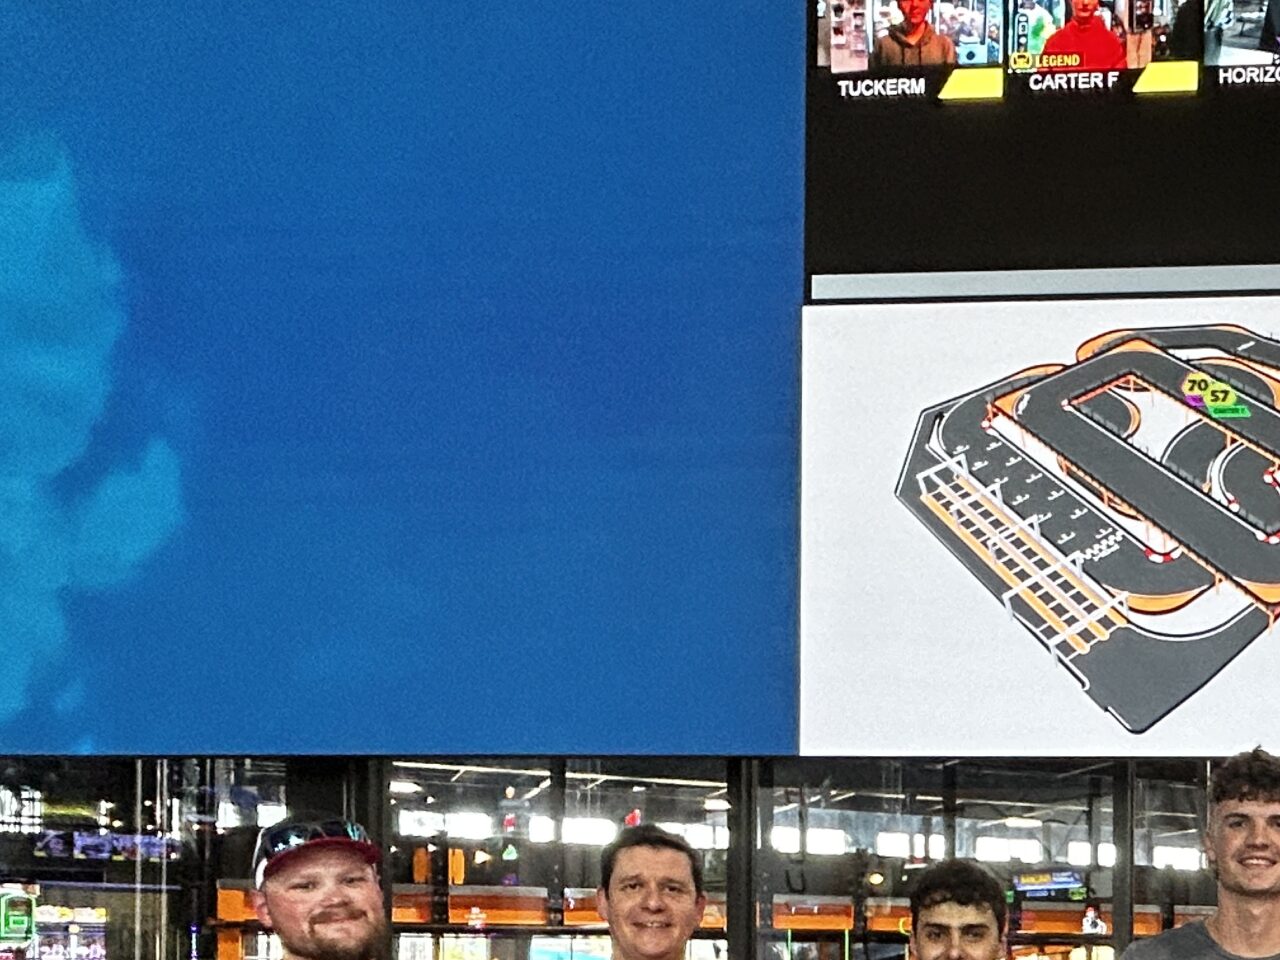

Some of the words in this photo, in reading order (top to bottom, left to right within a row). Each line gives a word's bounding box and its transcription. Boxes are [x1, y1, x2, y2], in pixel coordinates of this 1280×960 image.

[1035, 53, 1081, 68] LEGEND
[837, 77, 926, 97] TUCKERM
[1029, 73, 1103, 91] CARTER
[1108, 71, 1119, 88] F
[1187, 379, 1209, 392] 70
[1210, 389, 1230, 402] 57
